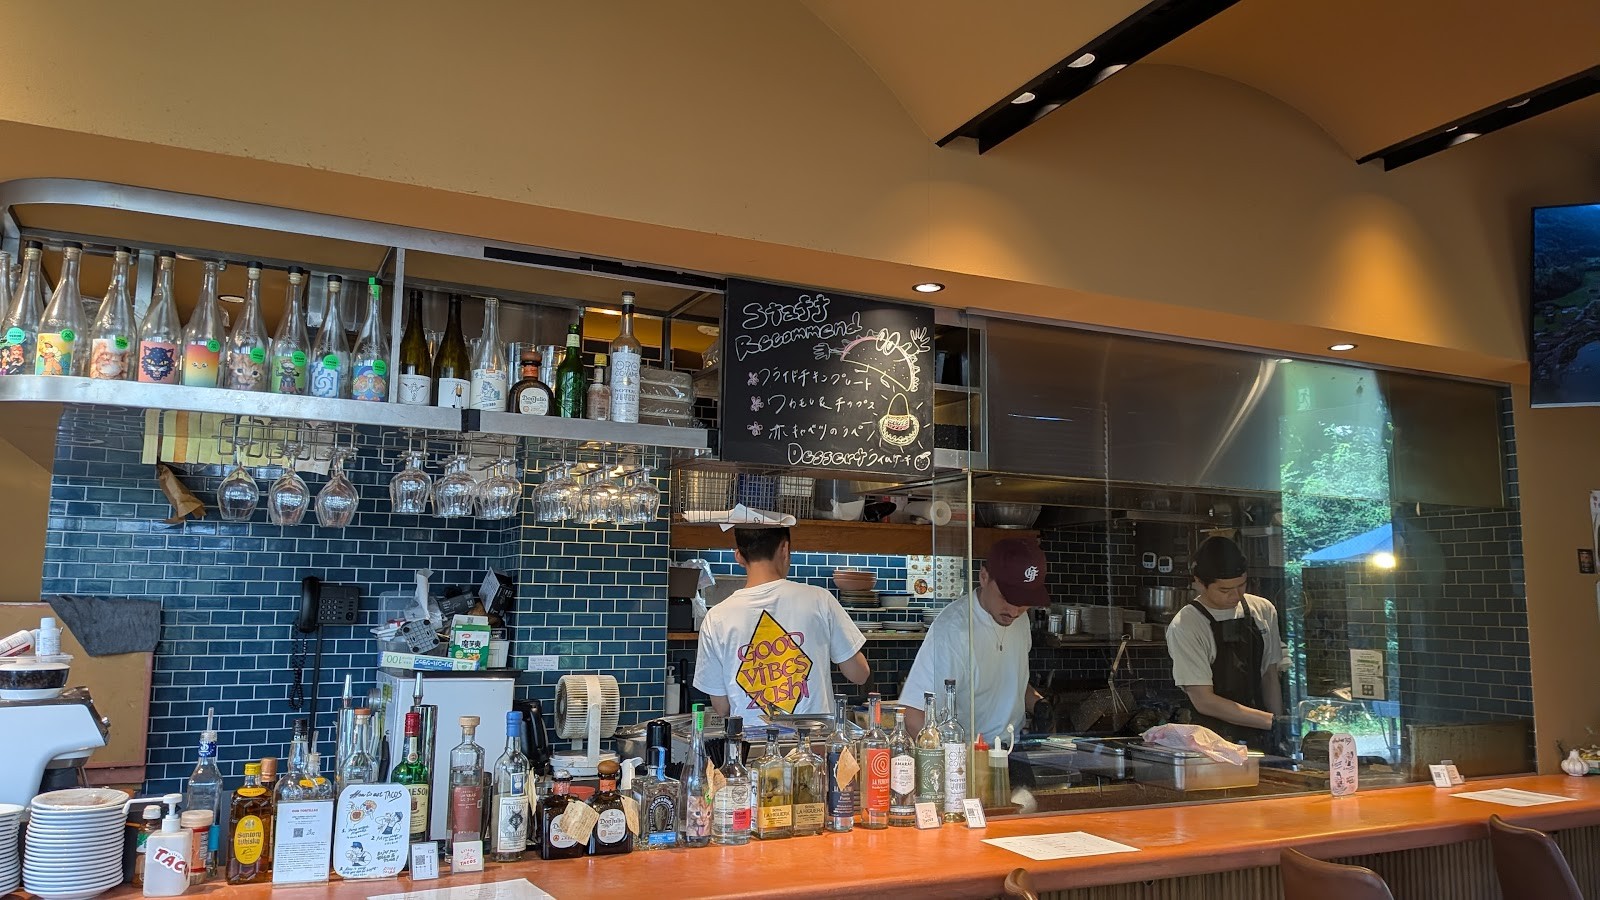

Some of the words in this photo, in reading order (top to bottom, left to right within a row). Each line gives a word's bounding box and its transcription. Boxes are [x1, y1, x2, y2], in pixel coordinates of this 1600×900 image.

[741, 293, 831, 330] Staff
[735, 311, 863, 361] Recommend
[759, 367, 872, 391] フライドチキンプレート
[787, 442, 867, 467] Dessert
[461, 640, 482, 649] 魔芋爽
[737, 631, 805, 667] GOOD
[383, 790, 403, 801] TACOS
[237, 831, 262, 839] Suntory
